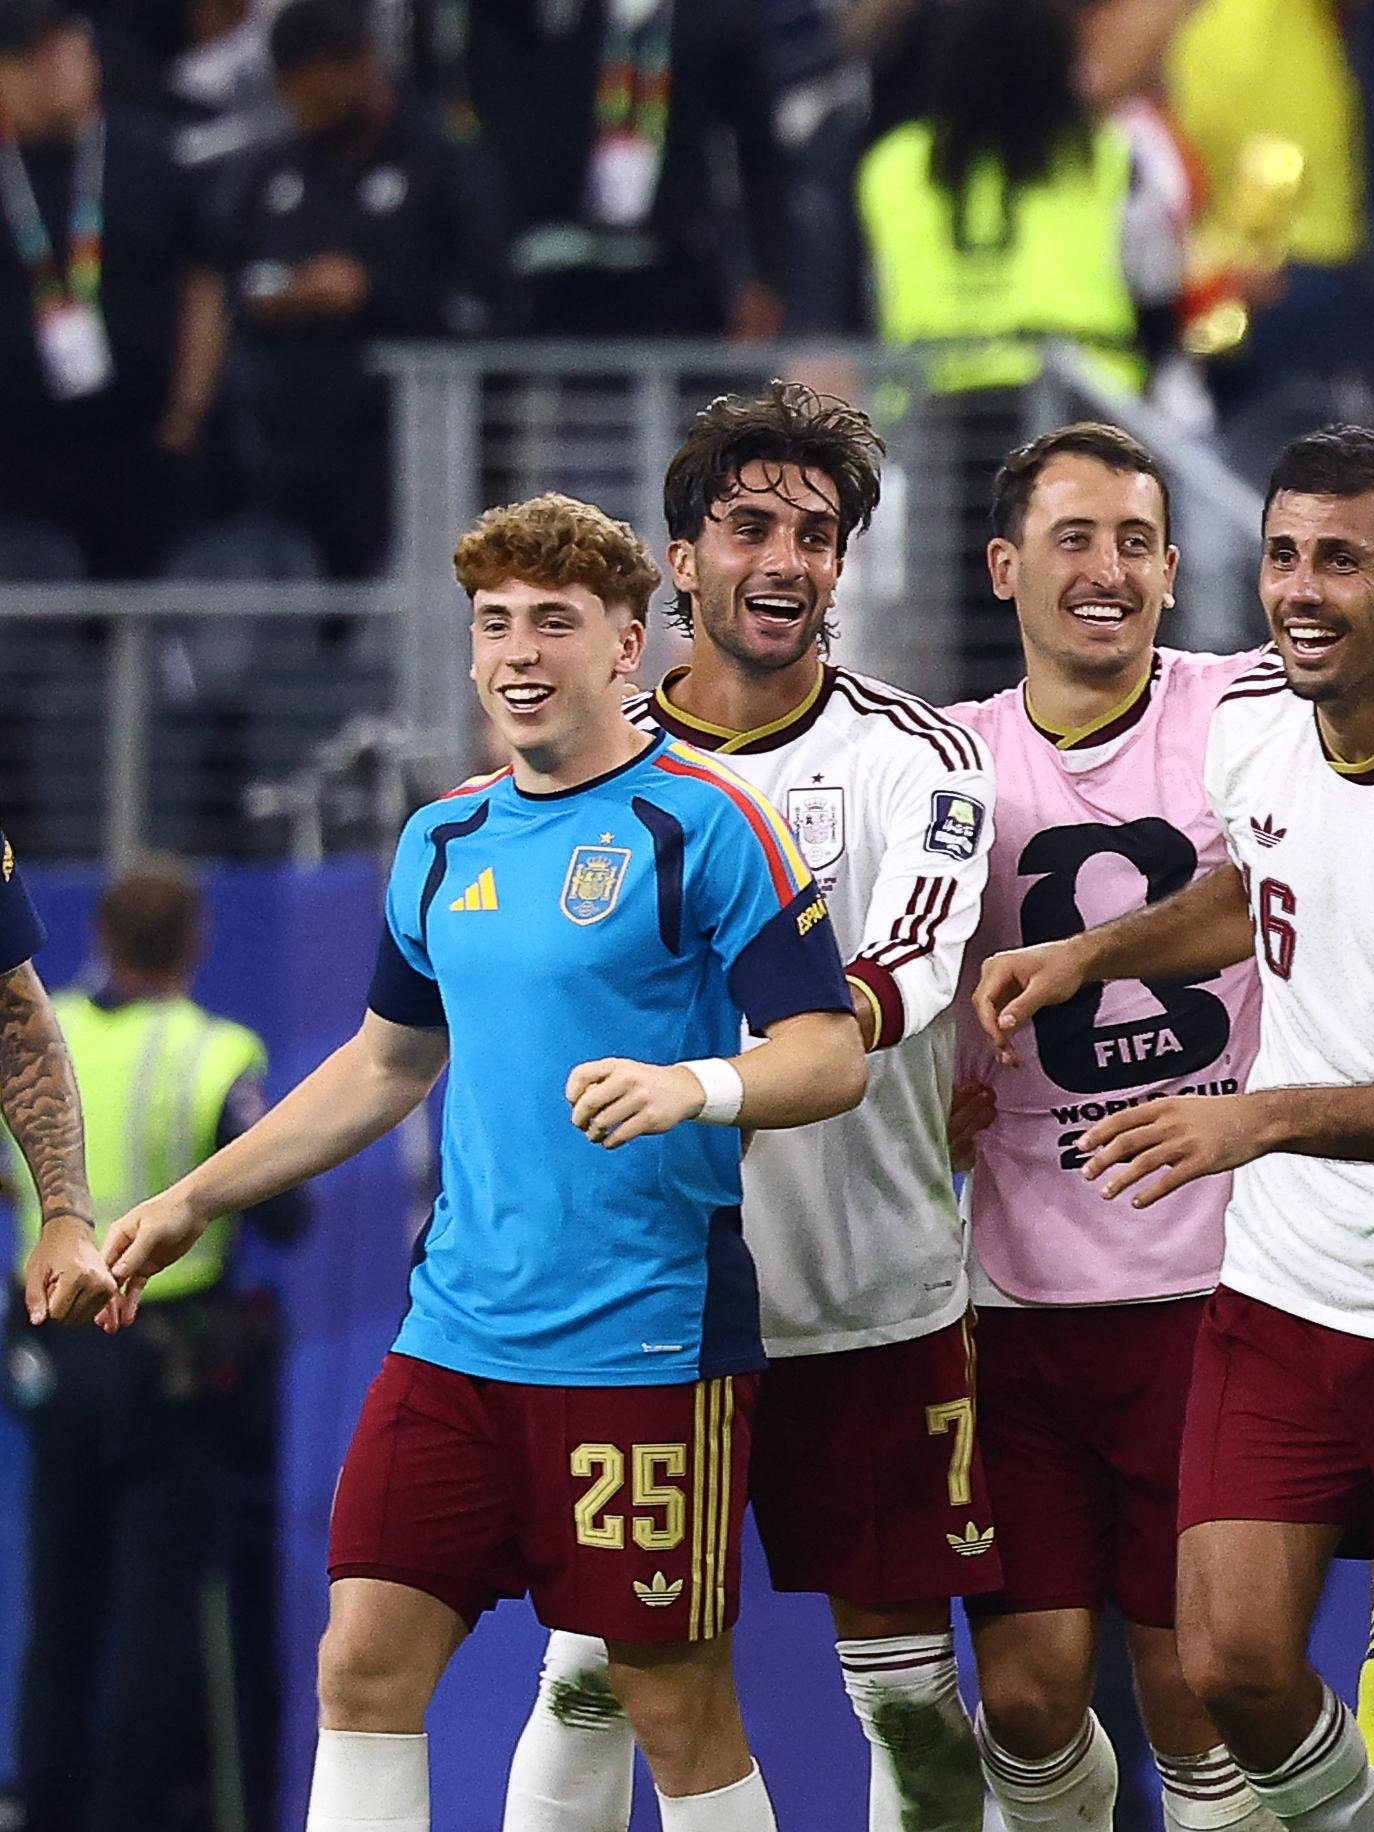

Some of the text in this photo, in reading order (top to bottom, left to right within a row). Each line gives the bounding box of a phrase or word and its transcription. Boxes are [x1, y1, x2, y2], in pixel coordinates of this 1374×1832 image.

[1243, 862, 1296, 982] 6
[1093, 1028, 1184, 1068] FIFA
[1051, 1092, 1169, 1125] WOR
[570, 1443, 688, 1551] 25
[925, 1397, 974, 1506] 7
